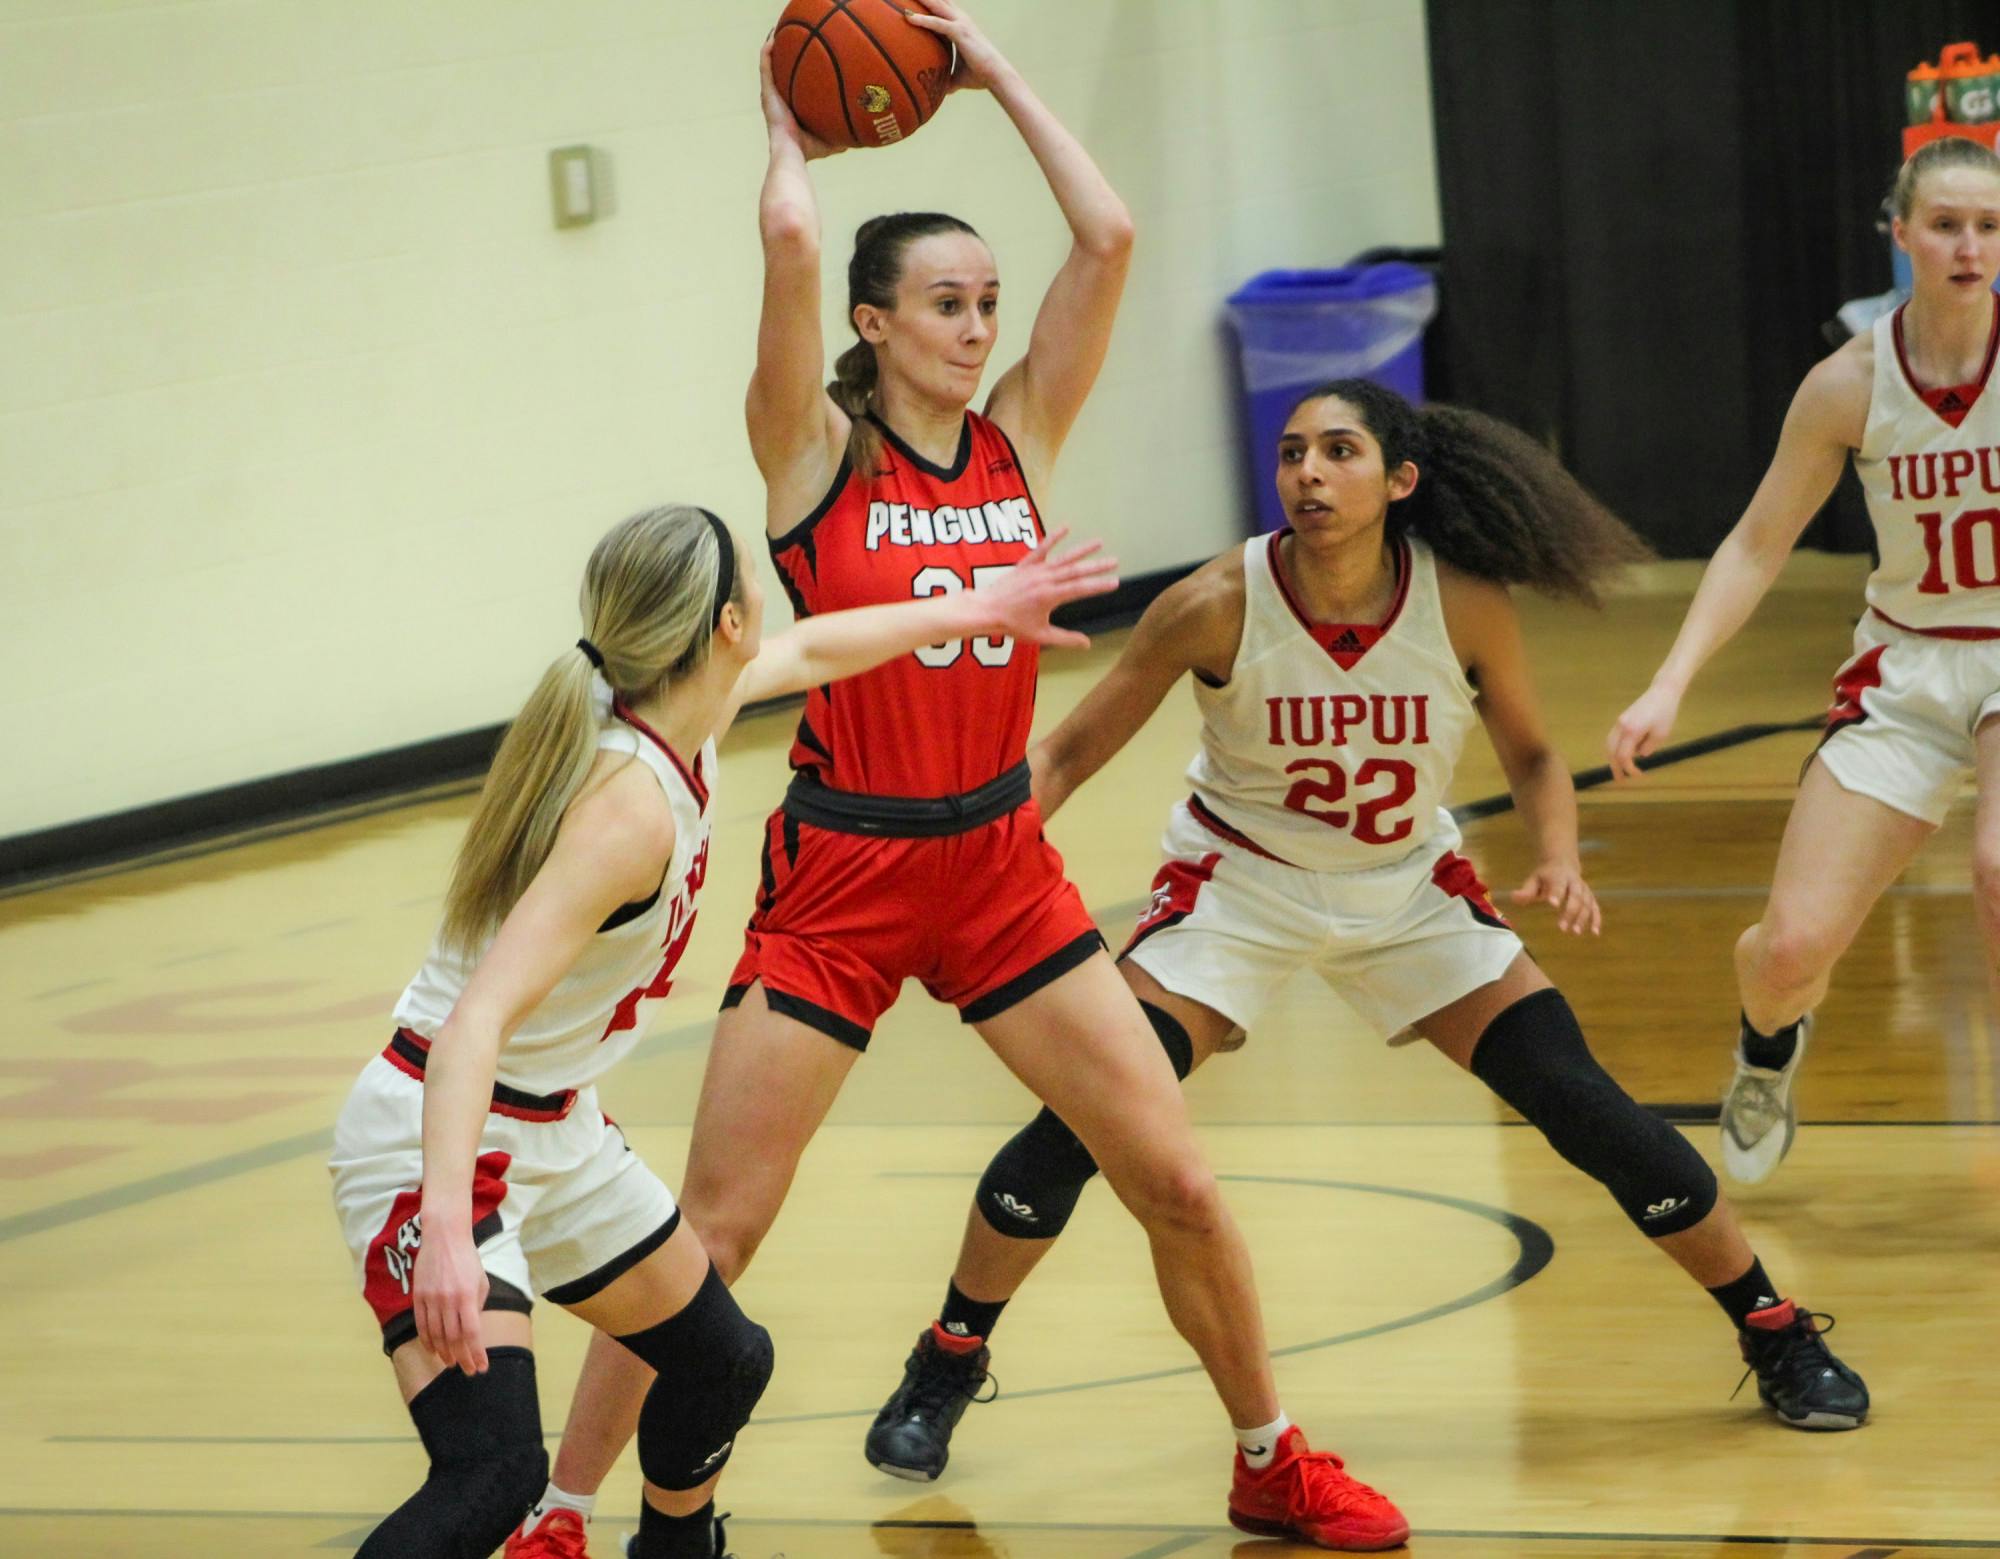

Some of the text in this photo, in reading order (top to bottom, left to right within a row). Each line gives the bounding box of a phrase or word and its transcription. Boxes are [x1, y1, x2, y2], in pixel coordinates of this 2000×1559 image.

[1914, 507, 2000, 595] 10
[1265, 694, 1430, 747] IUPUI
[1283, 757, 1417, 845] 22
